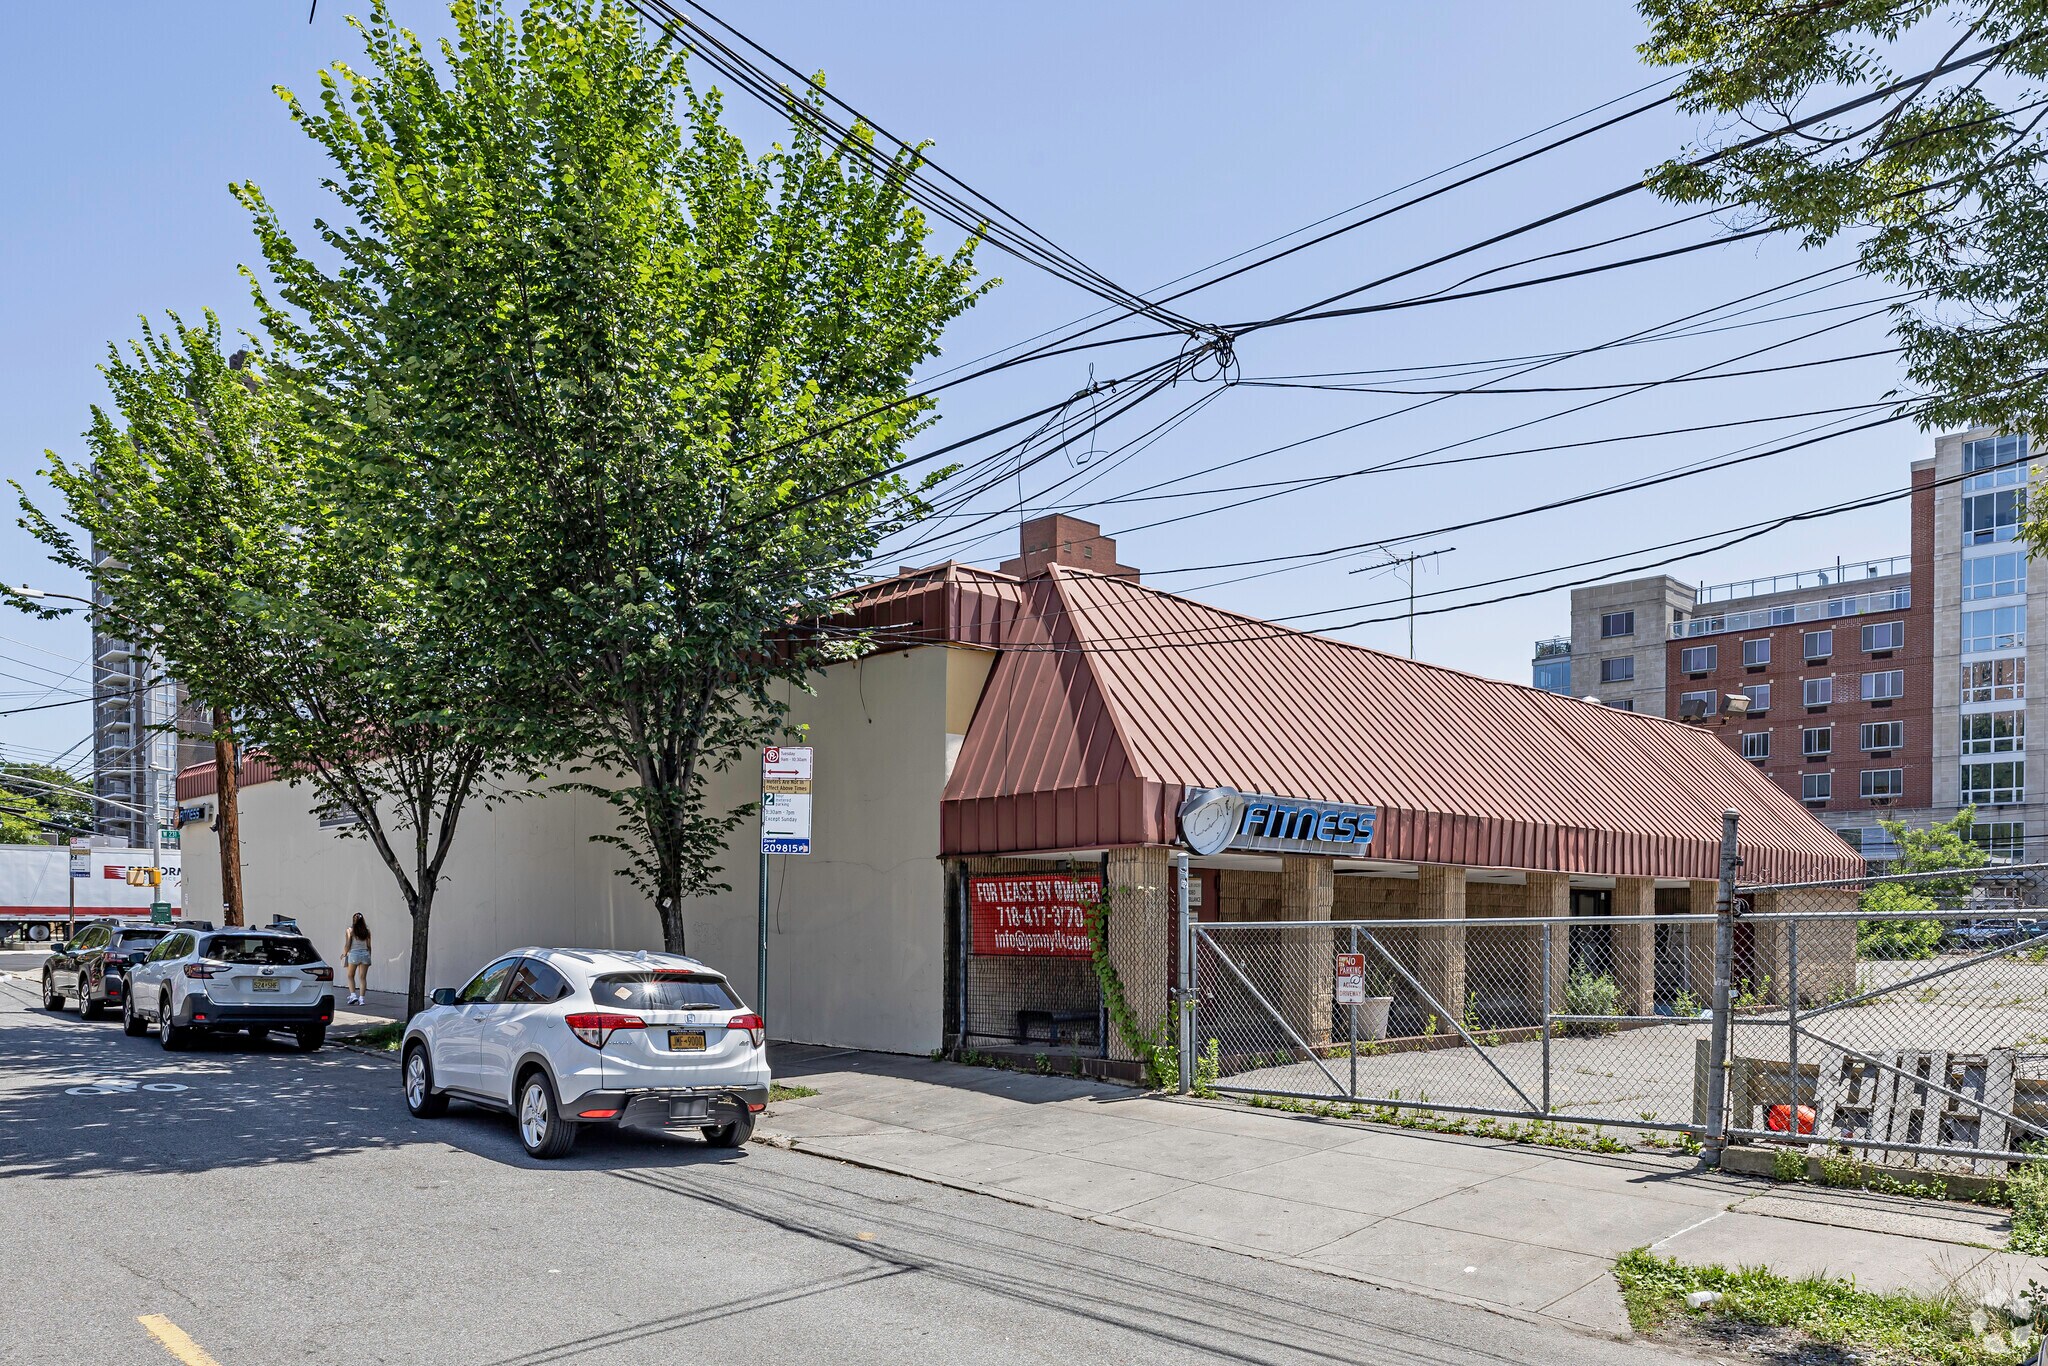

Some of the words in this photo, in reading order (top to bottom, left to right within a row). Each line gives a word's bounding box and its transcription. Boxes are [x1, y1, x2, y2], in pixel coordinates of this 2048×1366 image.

[765, 793, 774, 805] 2
[1241, 802, 1377, 845] FITNESS
[763, 844, 798, 853] 209815
[976, 882, 998, 902] FOR
[999, 881, 1034, 902] LEASE
[1035, 881, 1051, 902] BY
[1054, 880, 1100, 903] OWNER
[1339, 966, 1362, 975] PARKING
